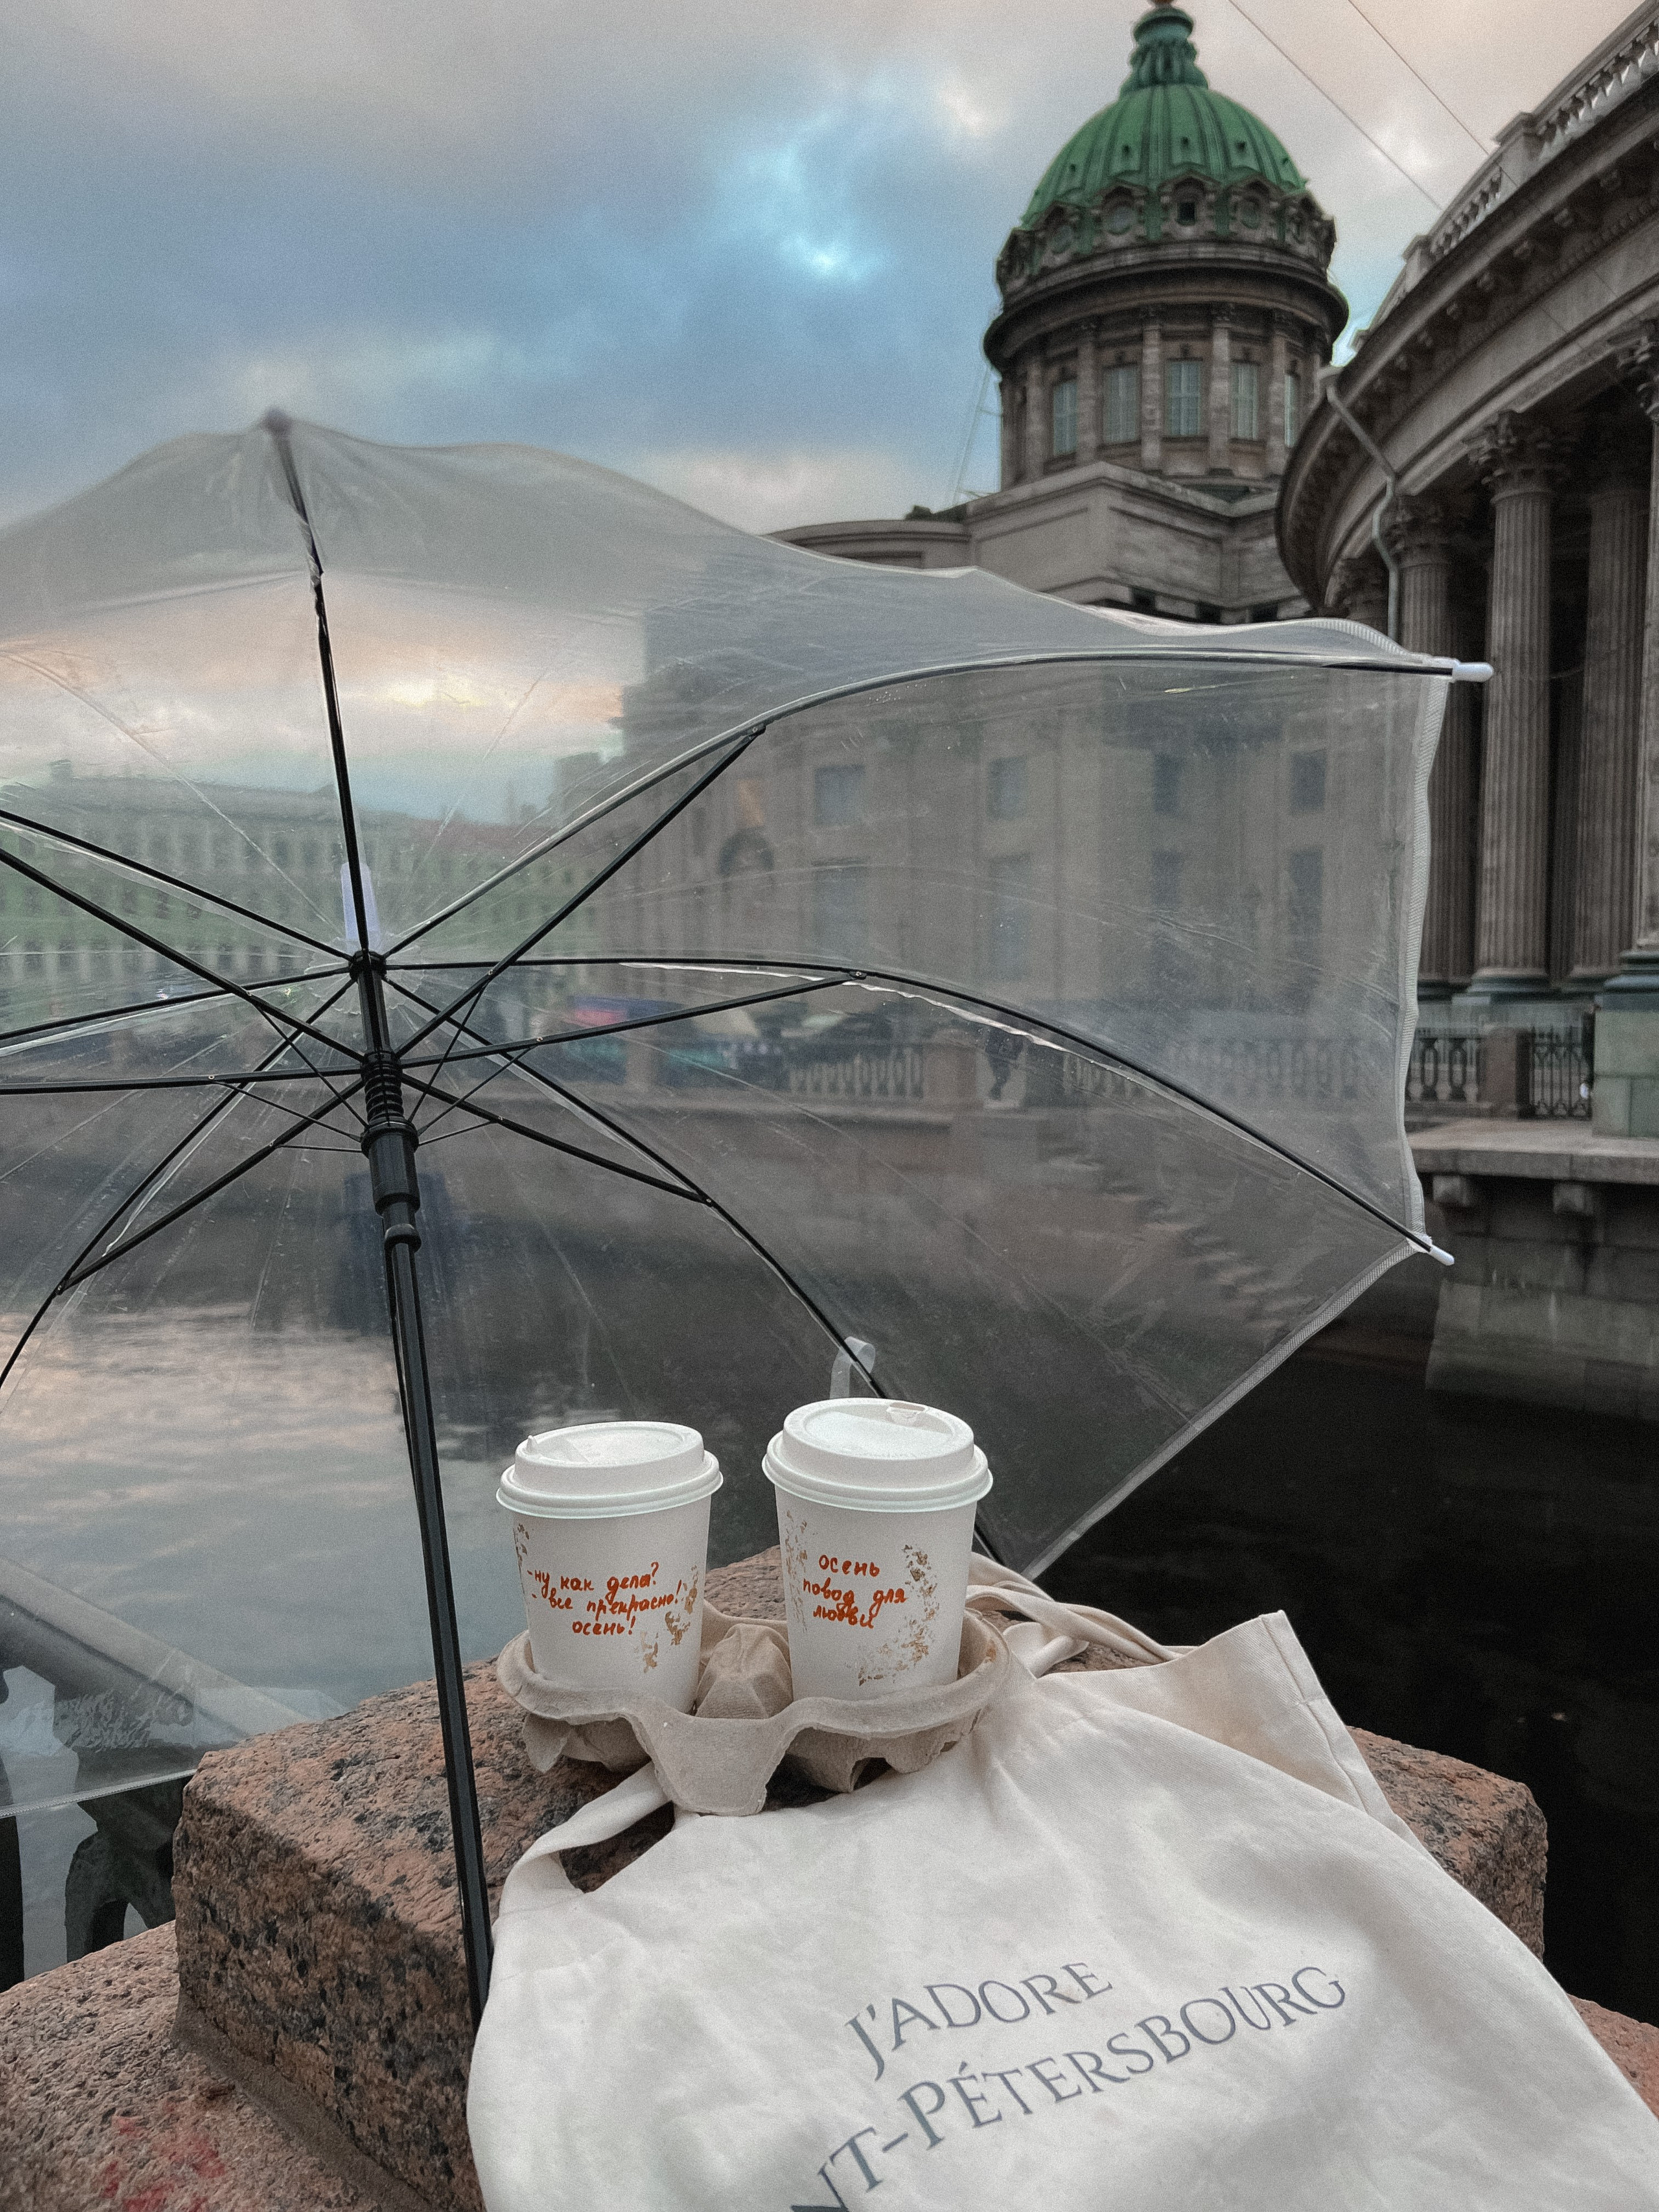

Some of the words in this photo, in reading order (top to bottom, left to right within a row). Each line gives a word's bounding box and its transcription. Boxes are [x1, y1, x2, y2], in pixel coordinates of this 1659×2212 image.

[818, 1555, 880, 1577] осень
[560, 1576, 594, 1591] как
[605, 1562, 659, 1604] дела?
[868, 1588, 907, 1618] для
[572, 1616, 636, 1636] осень!
